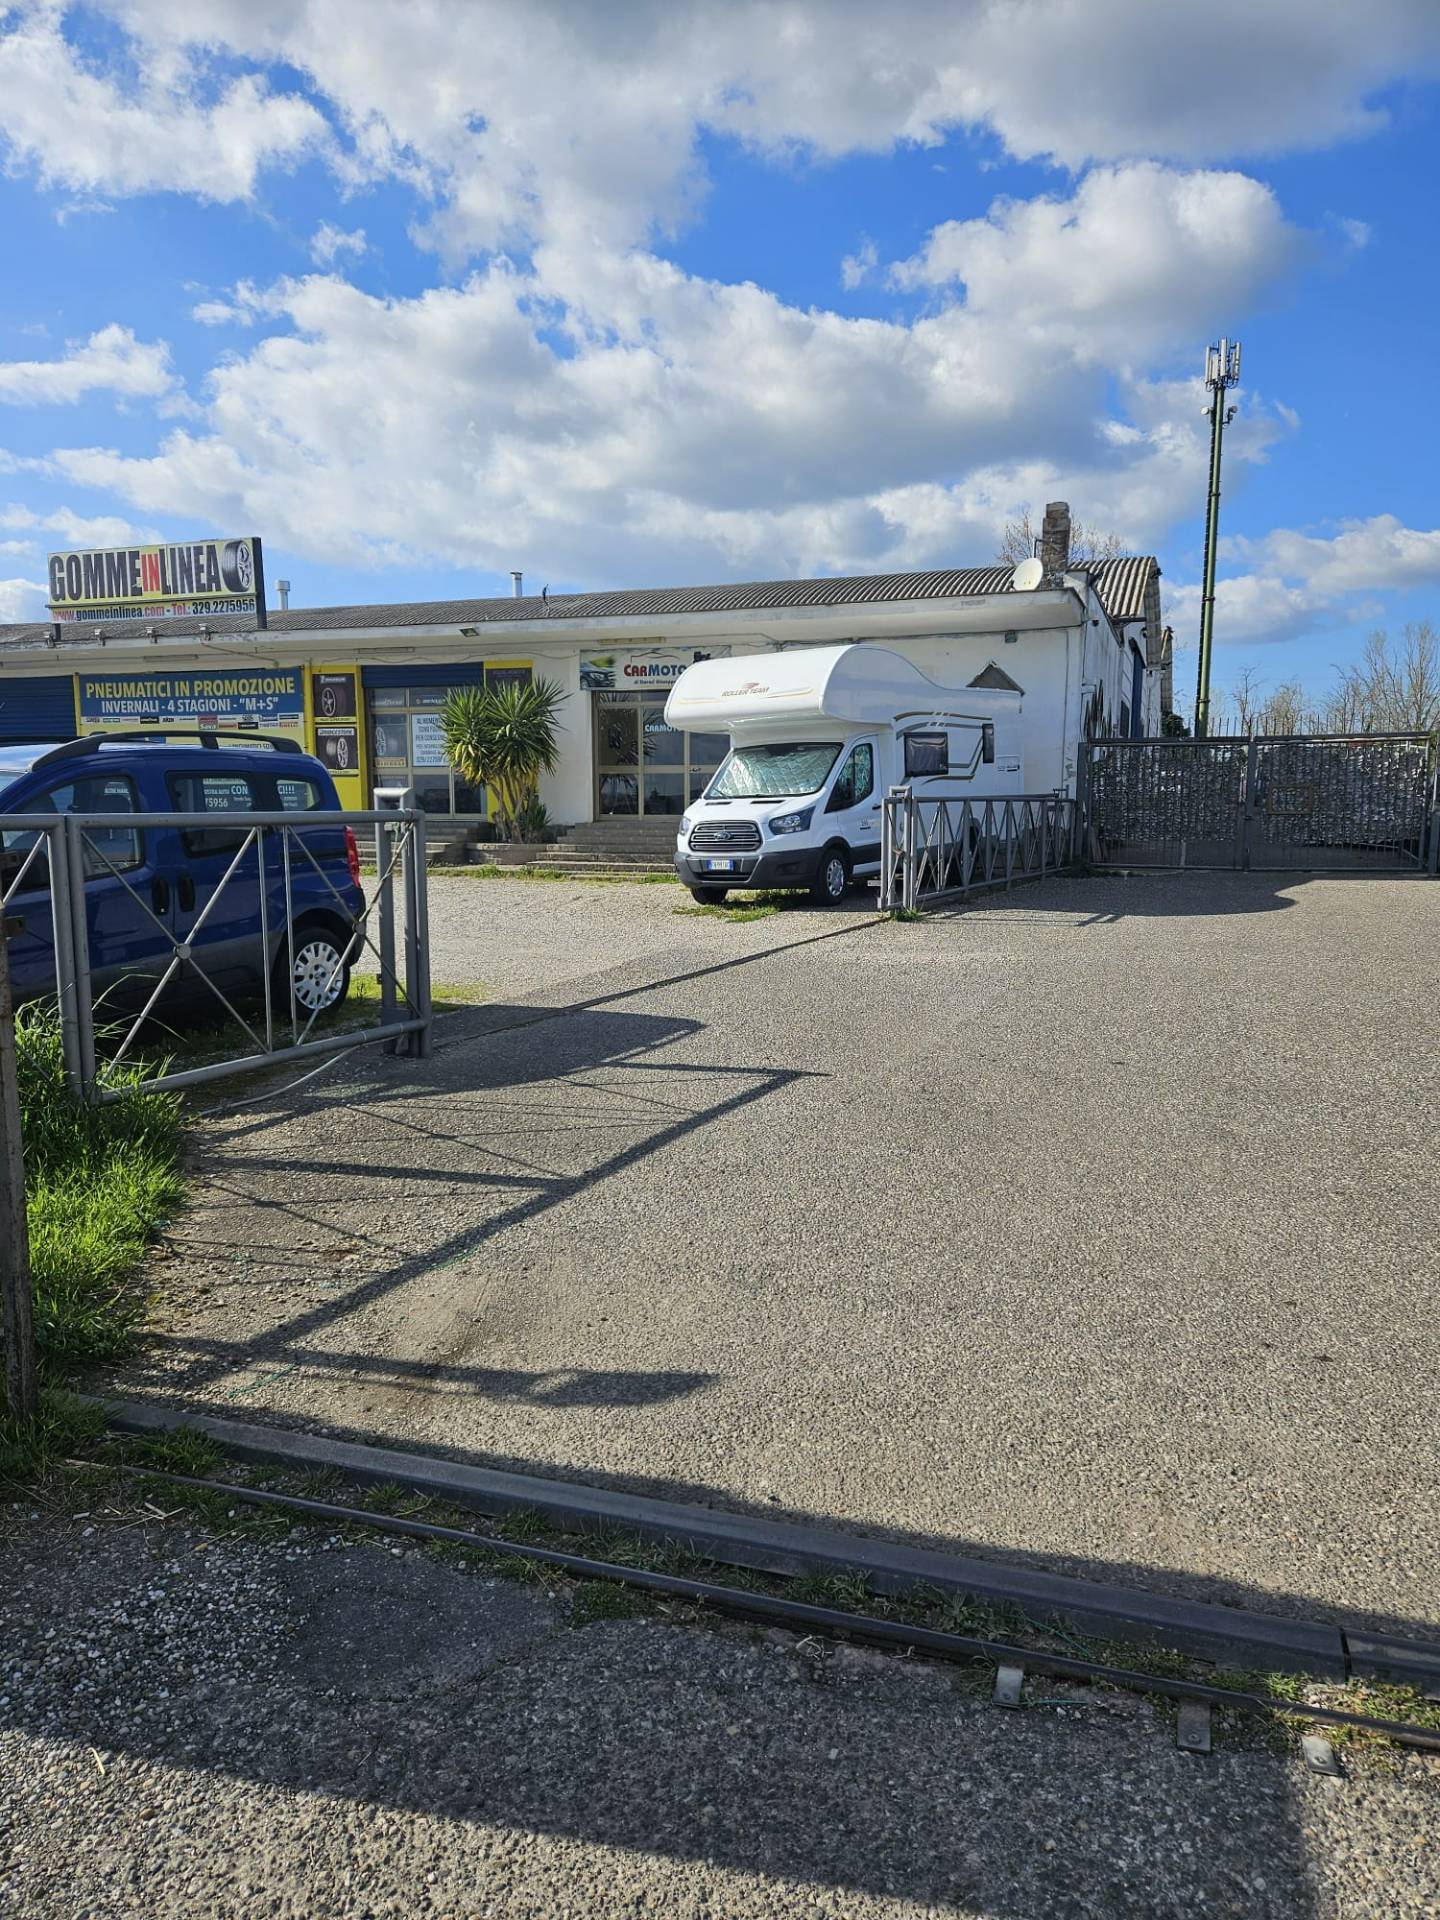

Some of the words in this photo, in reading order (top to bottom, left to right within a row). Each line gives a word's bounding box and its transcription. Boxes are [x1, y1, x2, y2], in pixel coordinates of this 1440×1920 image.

[192, 598, 255, 615] 329.2275956
[86, 681, 171, 699] PNEUMATICI
[174, 680, 191, 698] IN
[194, 676, 295, 697] PROMOZIONE
[101, 699, 160, 713] INVERNALI
[167, 699, 176, 713] 4
[177, 698, 231, 712] STAGIONI
